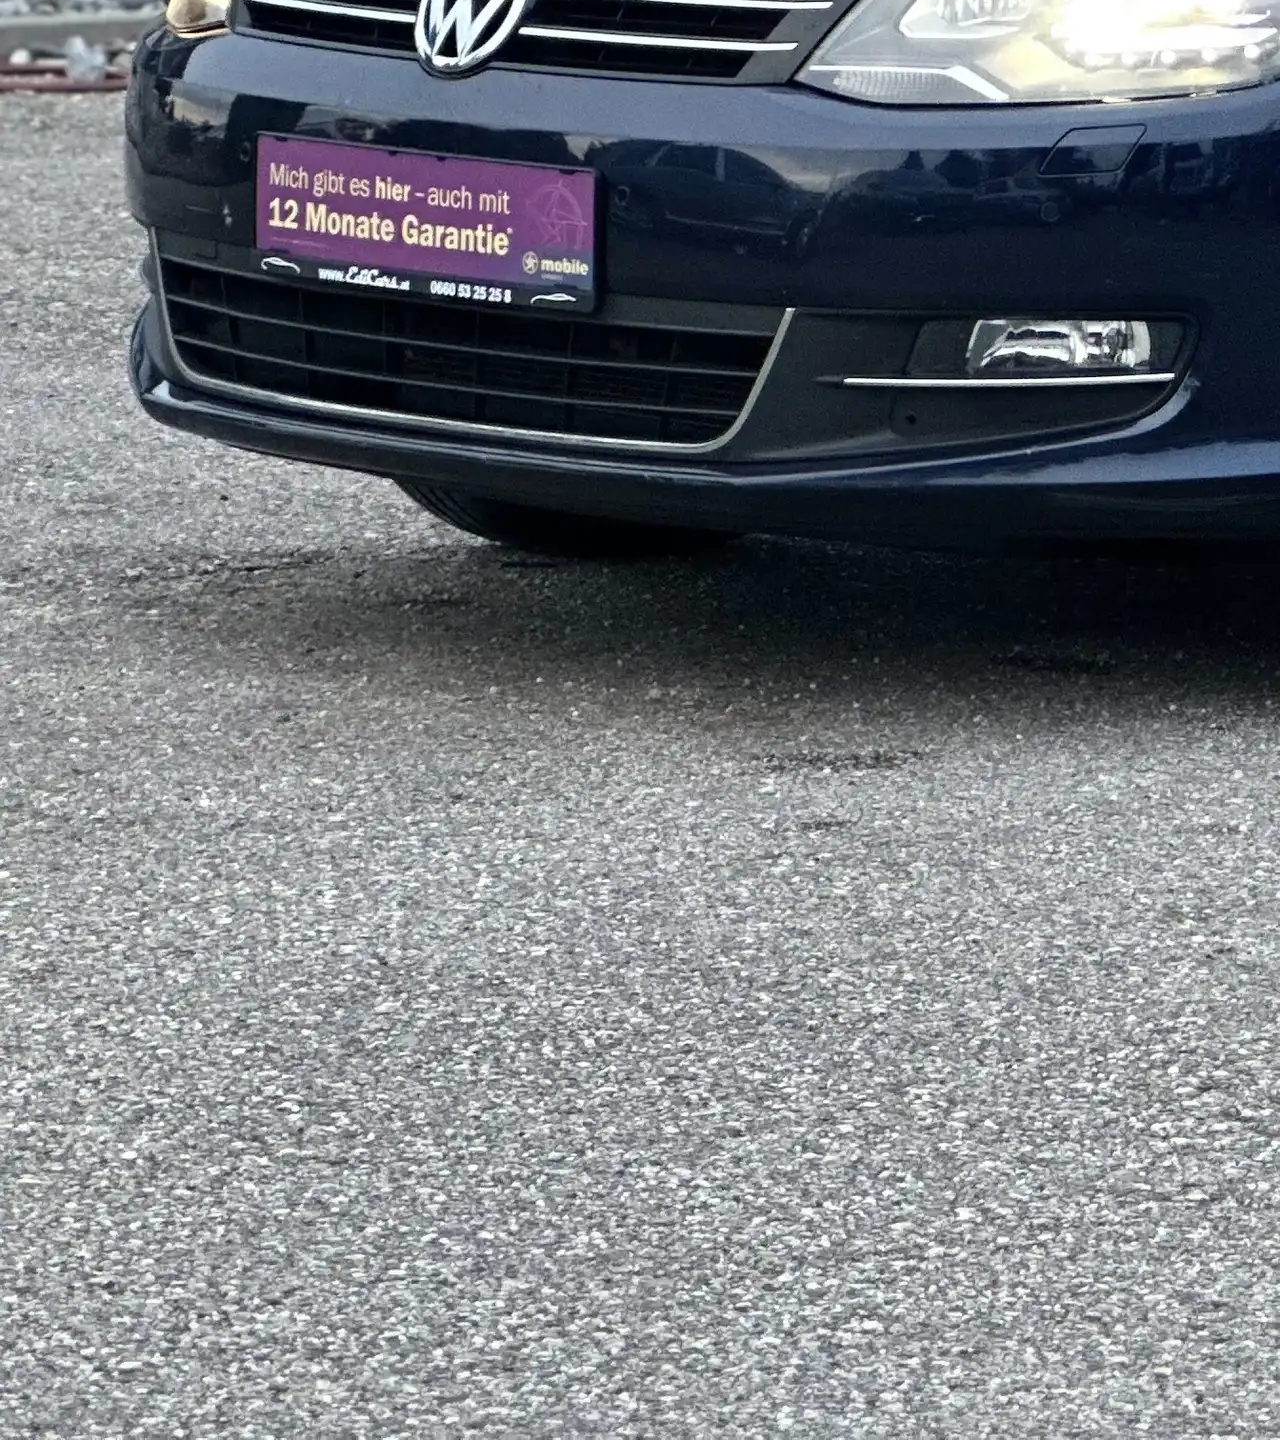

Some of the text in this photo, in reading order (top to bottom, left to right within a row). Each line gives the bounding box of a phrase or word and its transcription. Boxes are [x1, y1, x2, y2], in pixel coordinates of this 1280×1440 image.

[269, 162, 309, 190] Mich
[313, 169, 346, 197] gibt
[350, 177, 370, 197] es
[375, 175, 412, 202] hier
[427, 185, 472, 210] auch
[479, 189, 510, 215] mit
[268, 197, 298, 230] 12
[305, 201, 395, 242] Monate
[540, 257, 589, 275] mobile
[430, 280, 456, 297] 0660
[457, 283, 472, 299] 53
[473, 285, 487, 301] 25
[488, 287, 502, 302] 25
